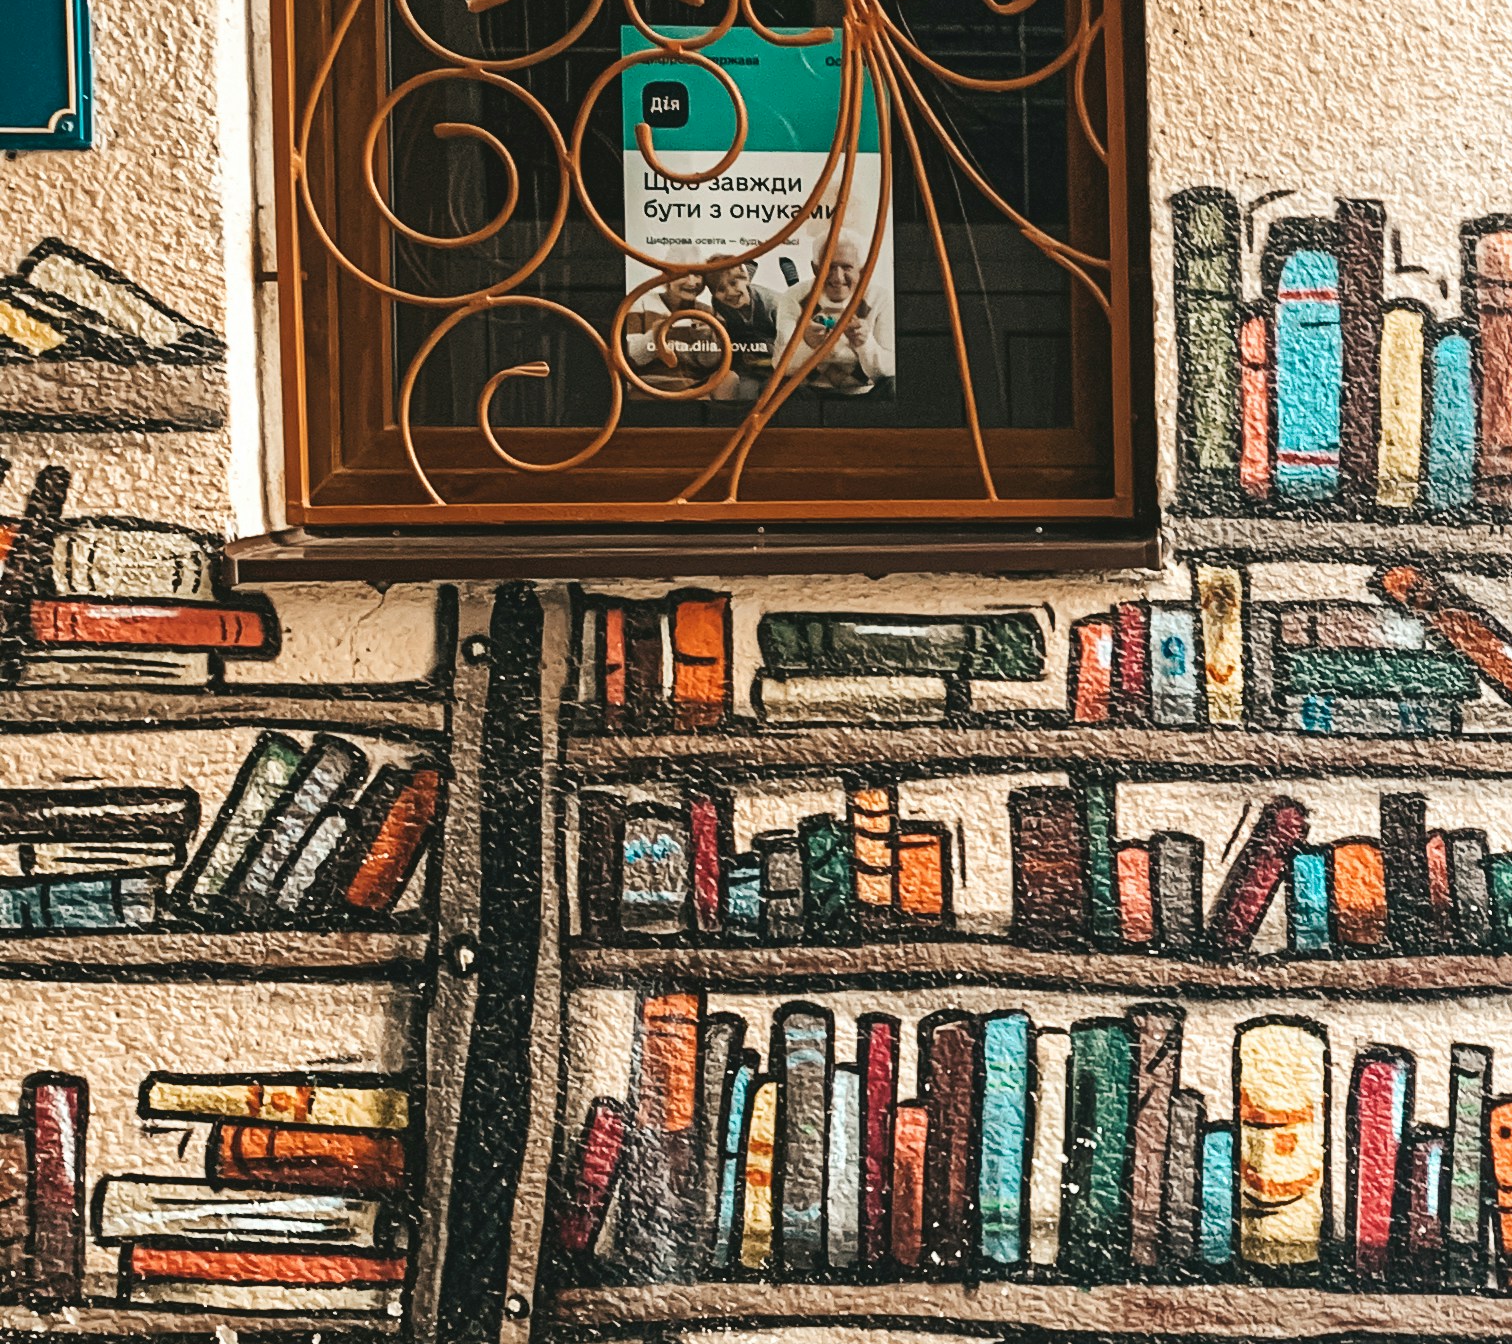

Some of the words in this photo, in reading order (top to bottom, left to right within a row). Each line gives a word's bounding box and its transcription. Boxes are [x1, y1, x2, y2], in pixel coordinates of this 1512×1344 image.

[703, 55, 760, 67] ржава
[650, 95, 680, 114] Дія
[708, 176, 802, 195] завжди
[644, 199, 701, 223] бути
[709, 203, 722, 219] з
[730, 203, 838, 223] онуками
[646, 236, 692, 246] Цифрова
[695, 237, 727, 246] освіта
[646, 340, 769, 353] oita.diia.ov.ua
